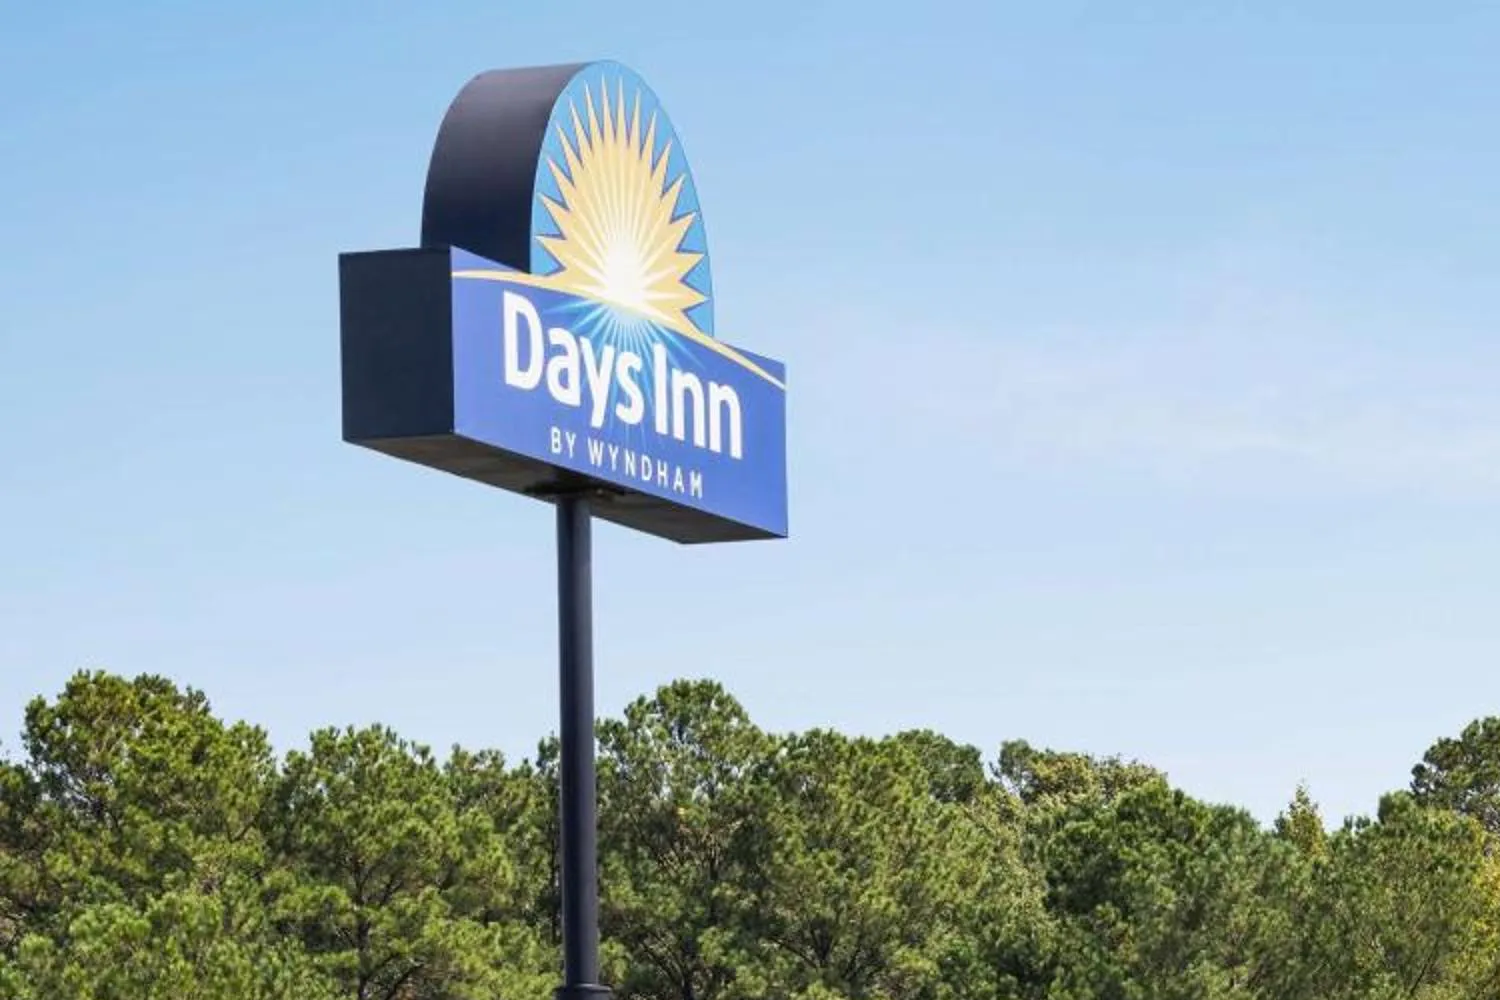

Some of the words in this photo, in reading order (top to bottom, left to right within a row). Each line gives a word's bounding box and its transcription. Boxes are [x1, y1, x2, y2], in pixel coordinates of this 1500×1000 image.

[503, 290, 645, 428] Days
[653, 342, 744, 460] Inn
[550, 426, 577, 459] BY
[587, 437, 704, 499] WYNDHAM
